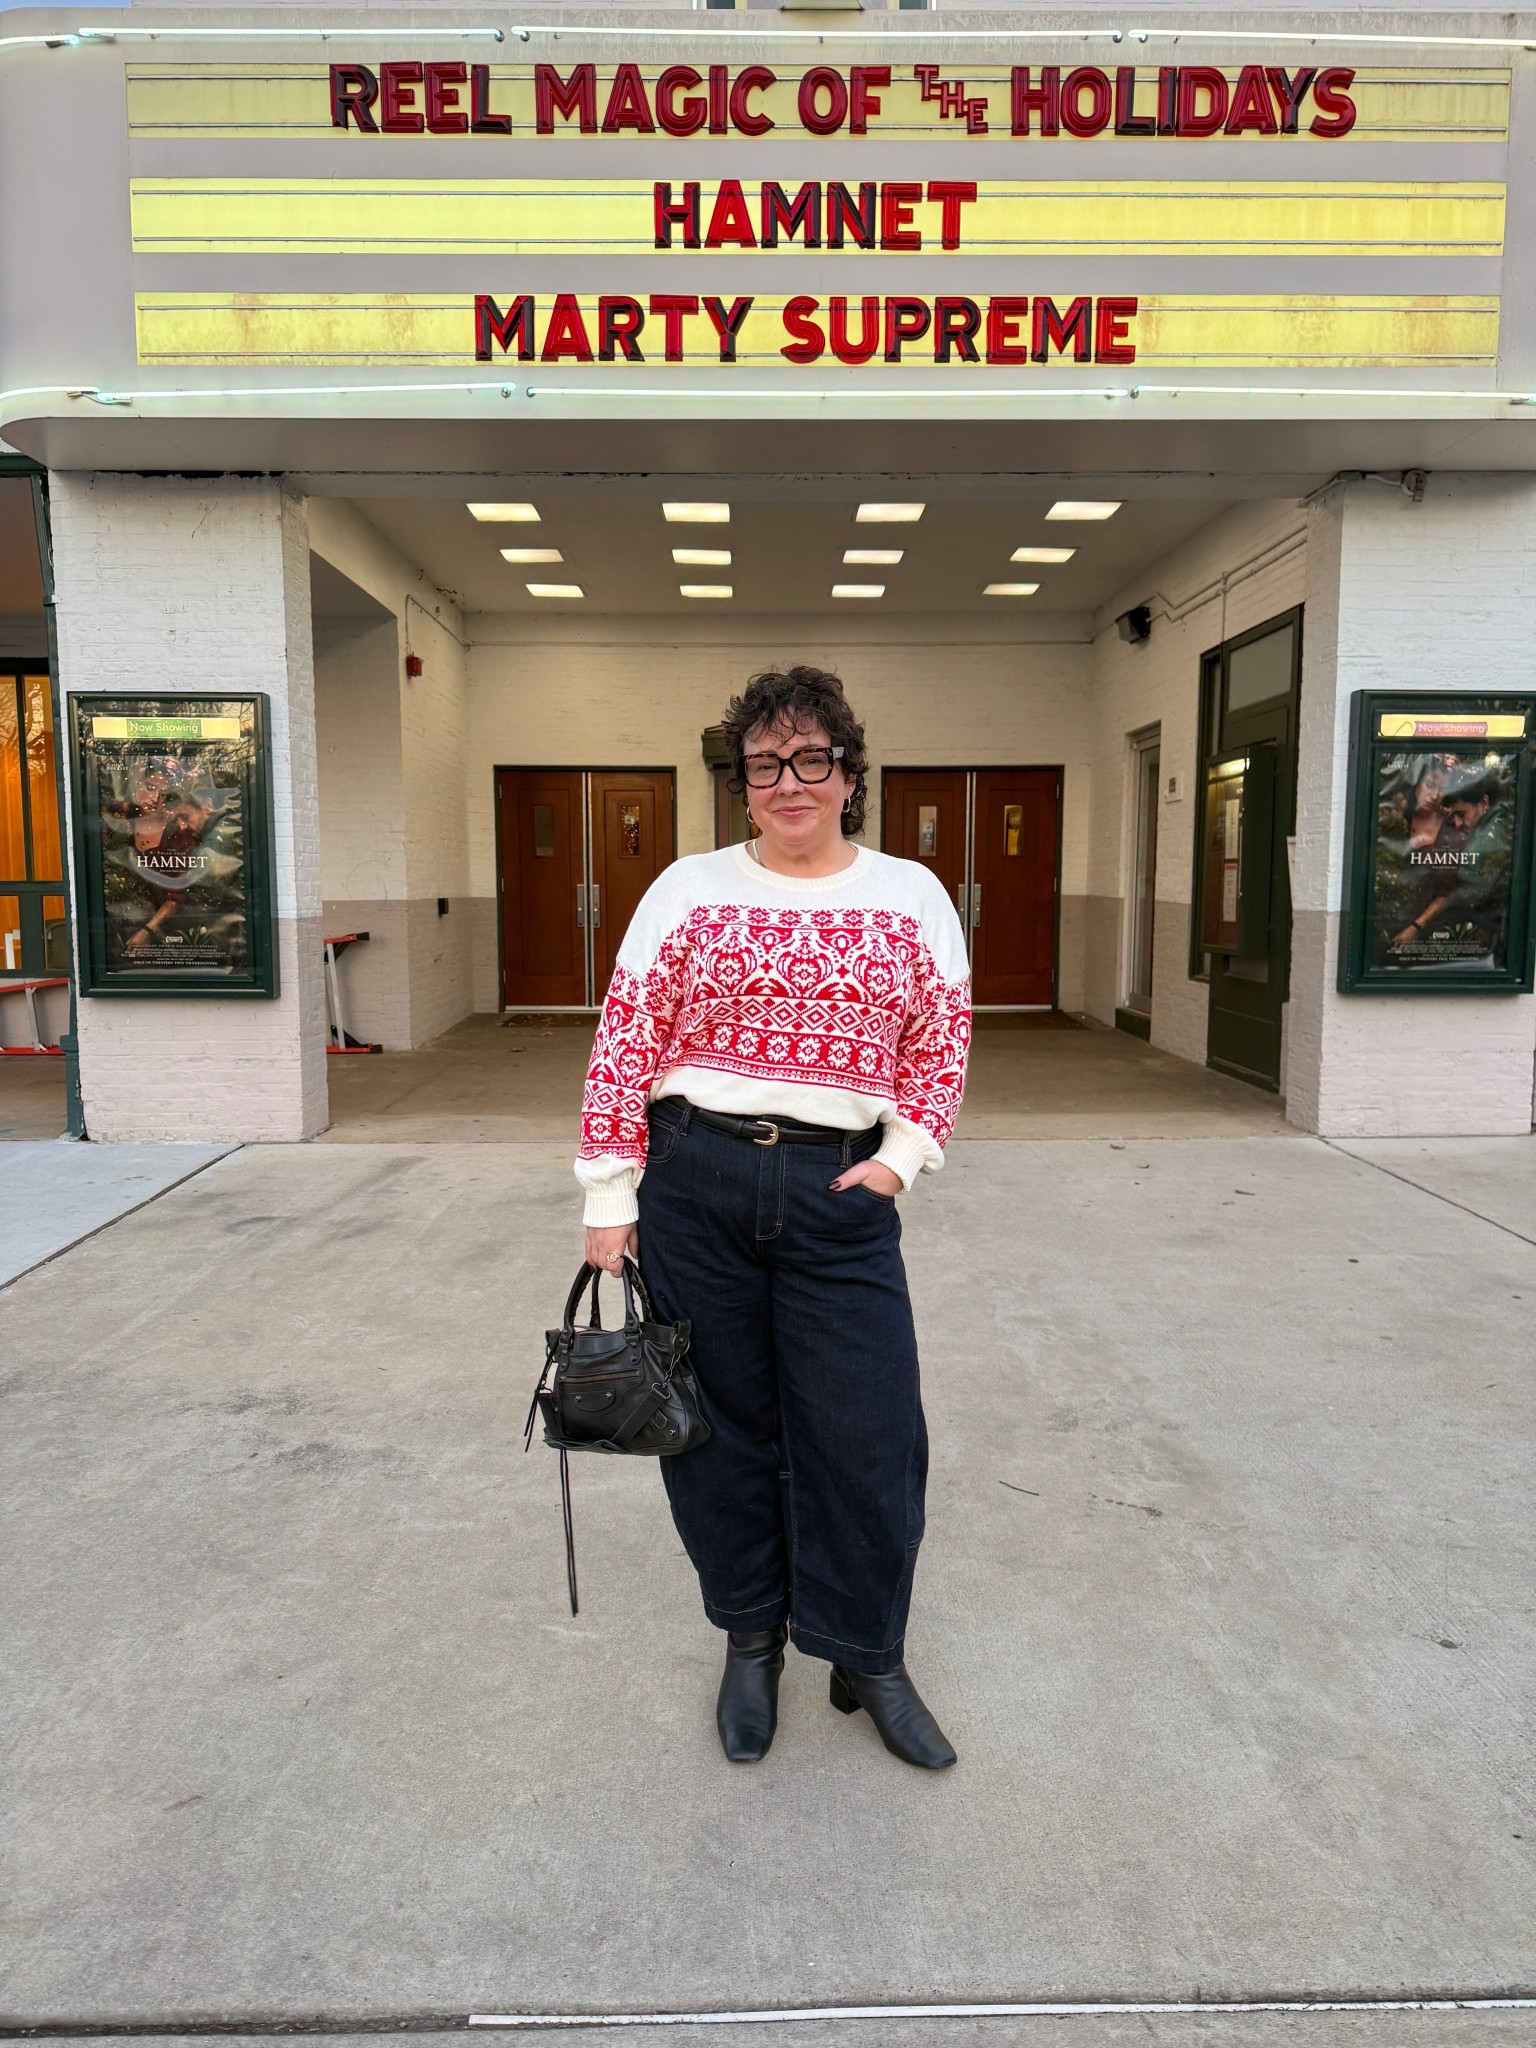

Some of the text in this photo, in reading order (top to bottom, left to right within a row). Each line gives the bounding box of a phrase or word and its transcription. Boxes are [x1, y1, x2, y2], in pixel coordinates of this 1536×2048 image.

[330, 62, 1356, 138] REEL MAGIC OF THE HOLIDAYS
[654, 179, 977, 251] HAMNET
[474, 294, 1137, 366] MARTY SUPREME
[130, 722, 199, 733] Now Showing
[1418, 723, 1441, 732] Now
[136, 855, 208, 868] HAMNET
[1410, 852, 1480, 865] HAMNET
